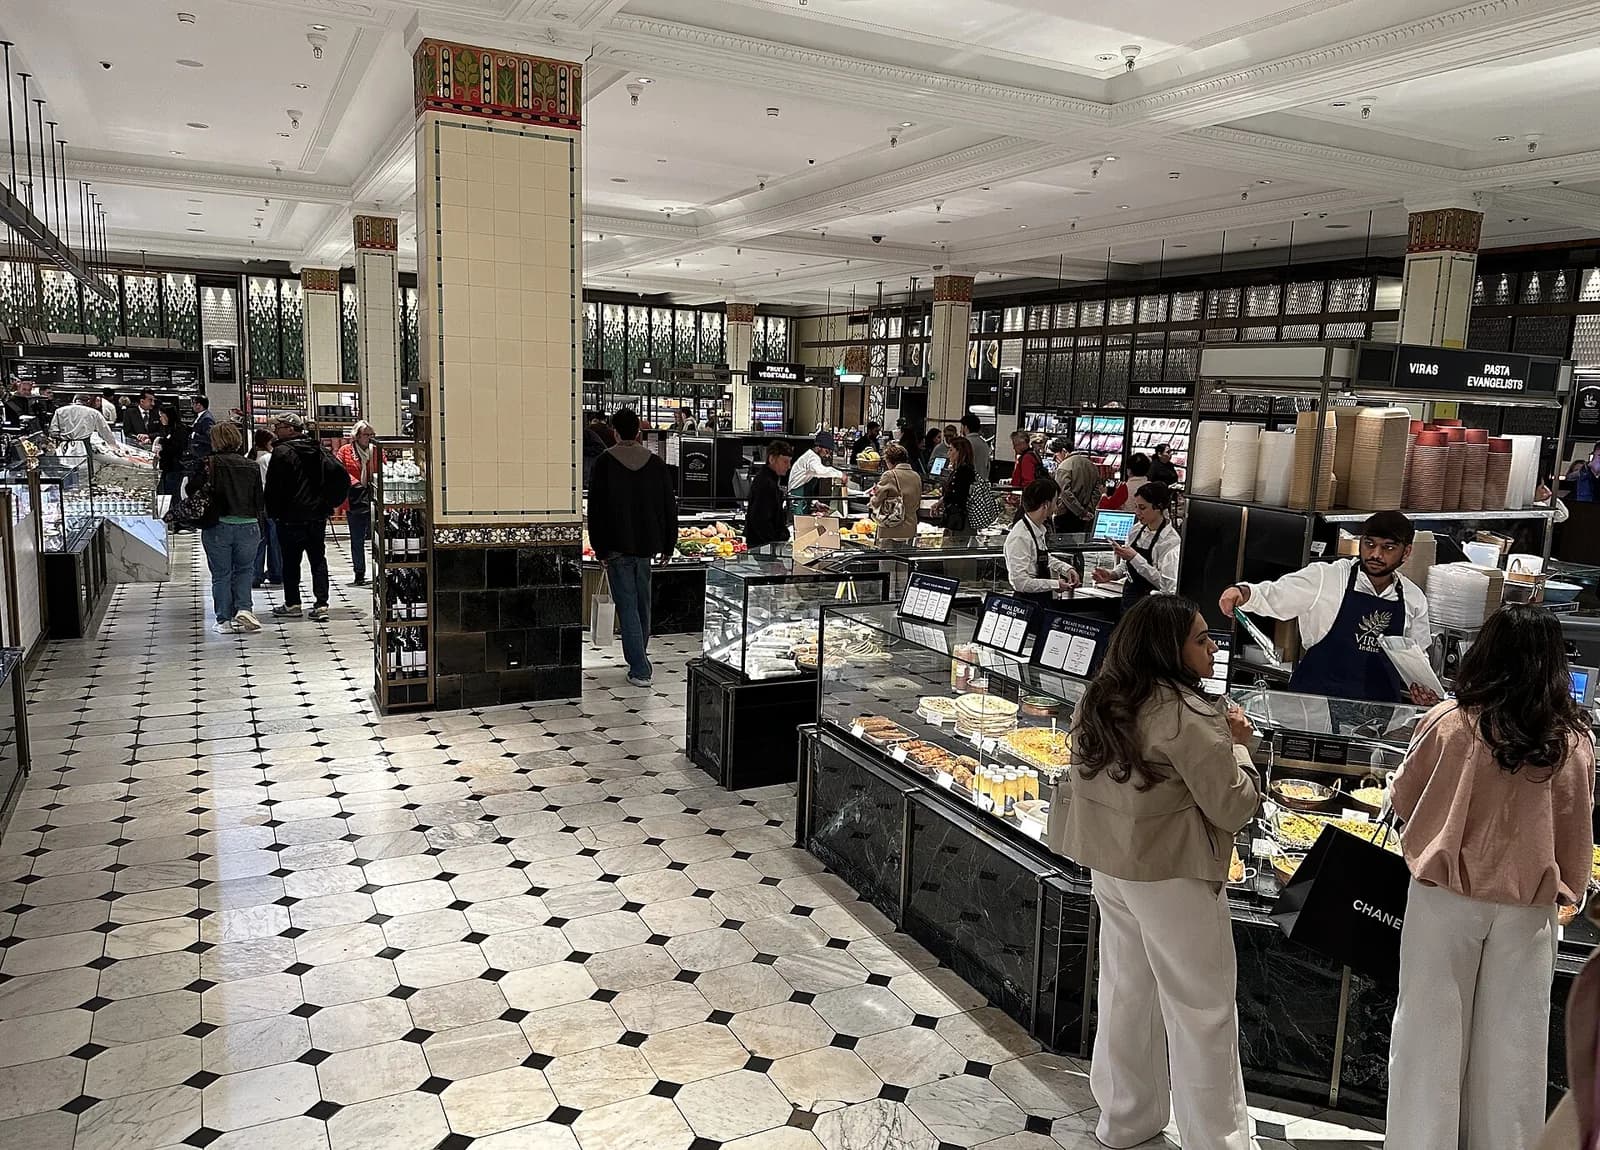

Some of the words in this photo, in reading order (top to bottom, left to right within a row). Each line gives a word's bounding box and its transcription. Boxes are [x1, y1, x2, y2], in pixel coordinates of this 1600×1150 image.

[758, 371, 797, 379] VEGETABLES
[1409, 362, 1440, 375] VIRAS
[1483, 364, 1510, 376] PASTA
[1466, 375, 1524, 390] EVANGELISTS
[1139, 386, 1187, 395] DELICATESSEN
[1354, 632, 1382, 647] VIRA
[1353, 899, 1403, 930] CHANE
